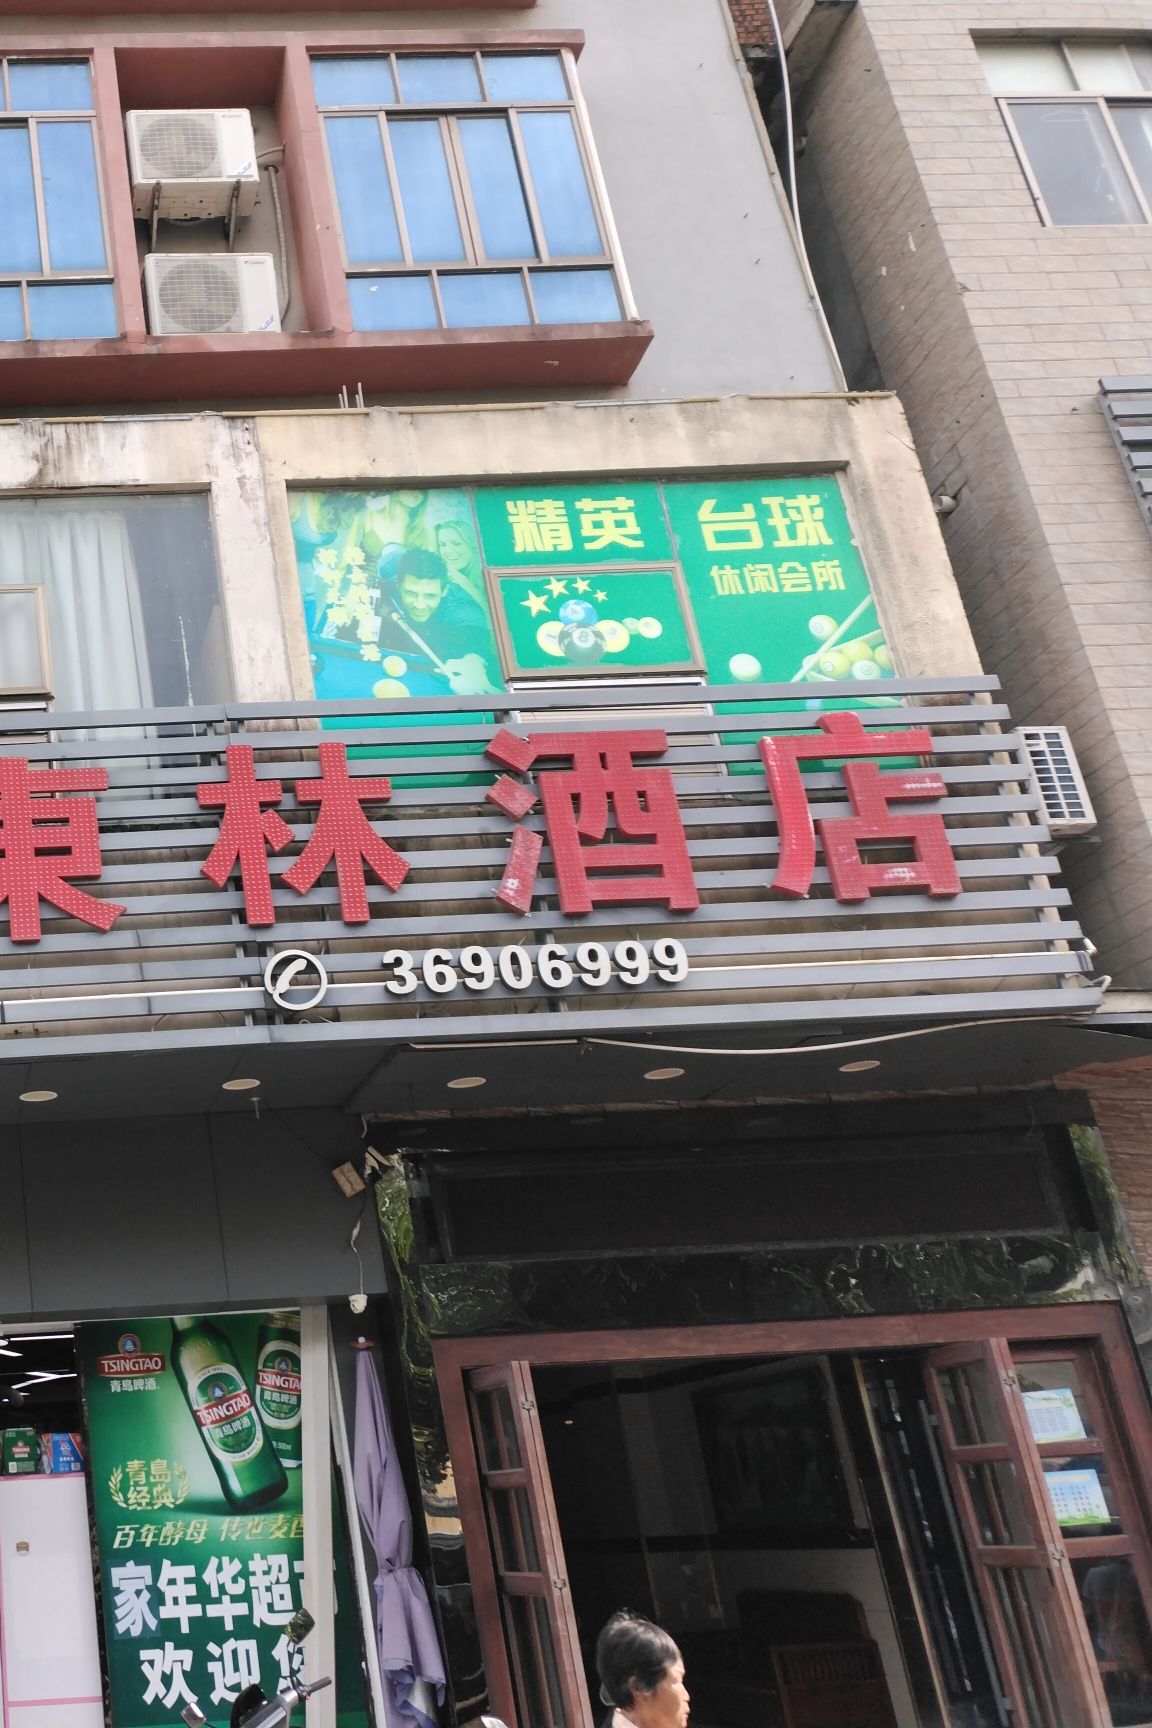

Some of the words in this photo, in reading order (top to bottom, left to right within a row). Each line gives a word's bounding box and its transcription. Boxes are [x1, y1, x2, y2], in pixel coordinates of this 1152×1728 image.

[505, 496, 645, 552] 精英
[697, 494, 834, 551] 台球
[709, 560, 846, 596] 休闲会所
[383, 937, 691, 996] 36906999
[101, 1357, 163, 1373] TSINGTAO
[258, 1372, 301, 1390] TSINGTA
[196, 1393, 251, 1424] TSINGTAO
[127, 1484, 175, 1511] 经典
[112, 1518, 208, 1549] 百年酵母
